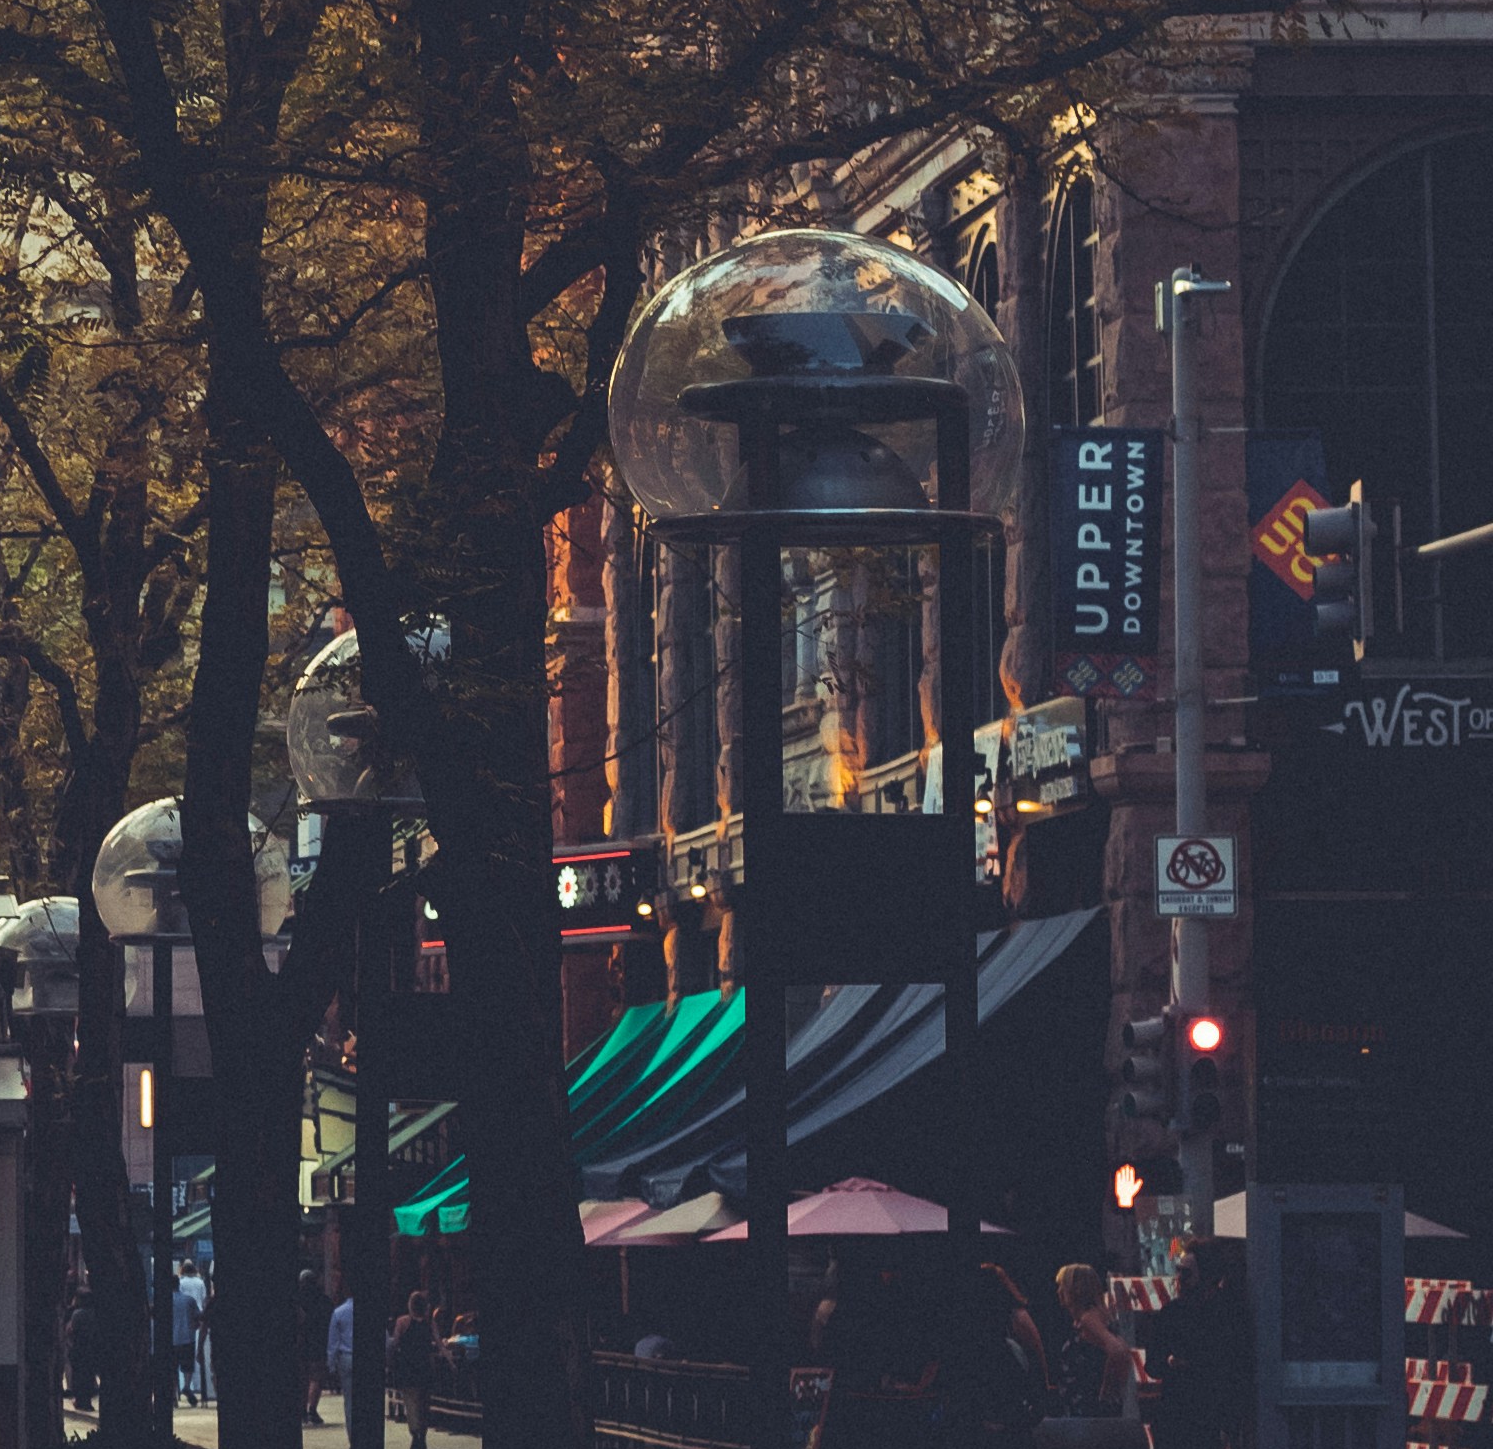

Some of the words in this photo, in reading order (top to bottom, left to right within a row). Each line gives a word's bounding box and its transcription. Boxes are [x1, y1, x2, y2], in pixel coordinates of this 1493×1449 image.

[1075, 440, 1113, 636] UPPER
[1122, 441, 1146, 635] DOWNTOWN
[1345, 683, 1473, 747] WEST
